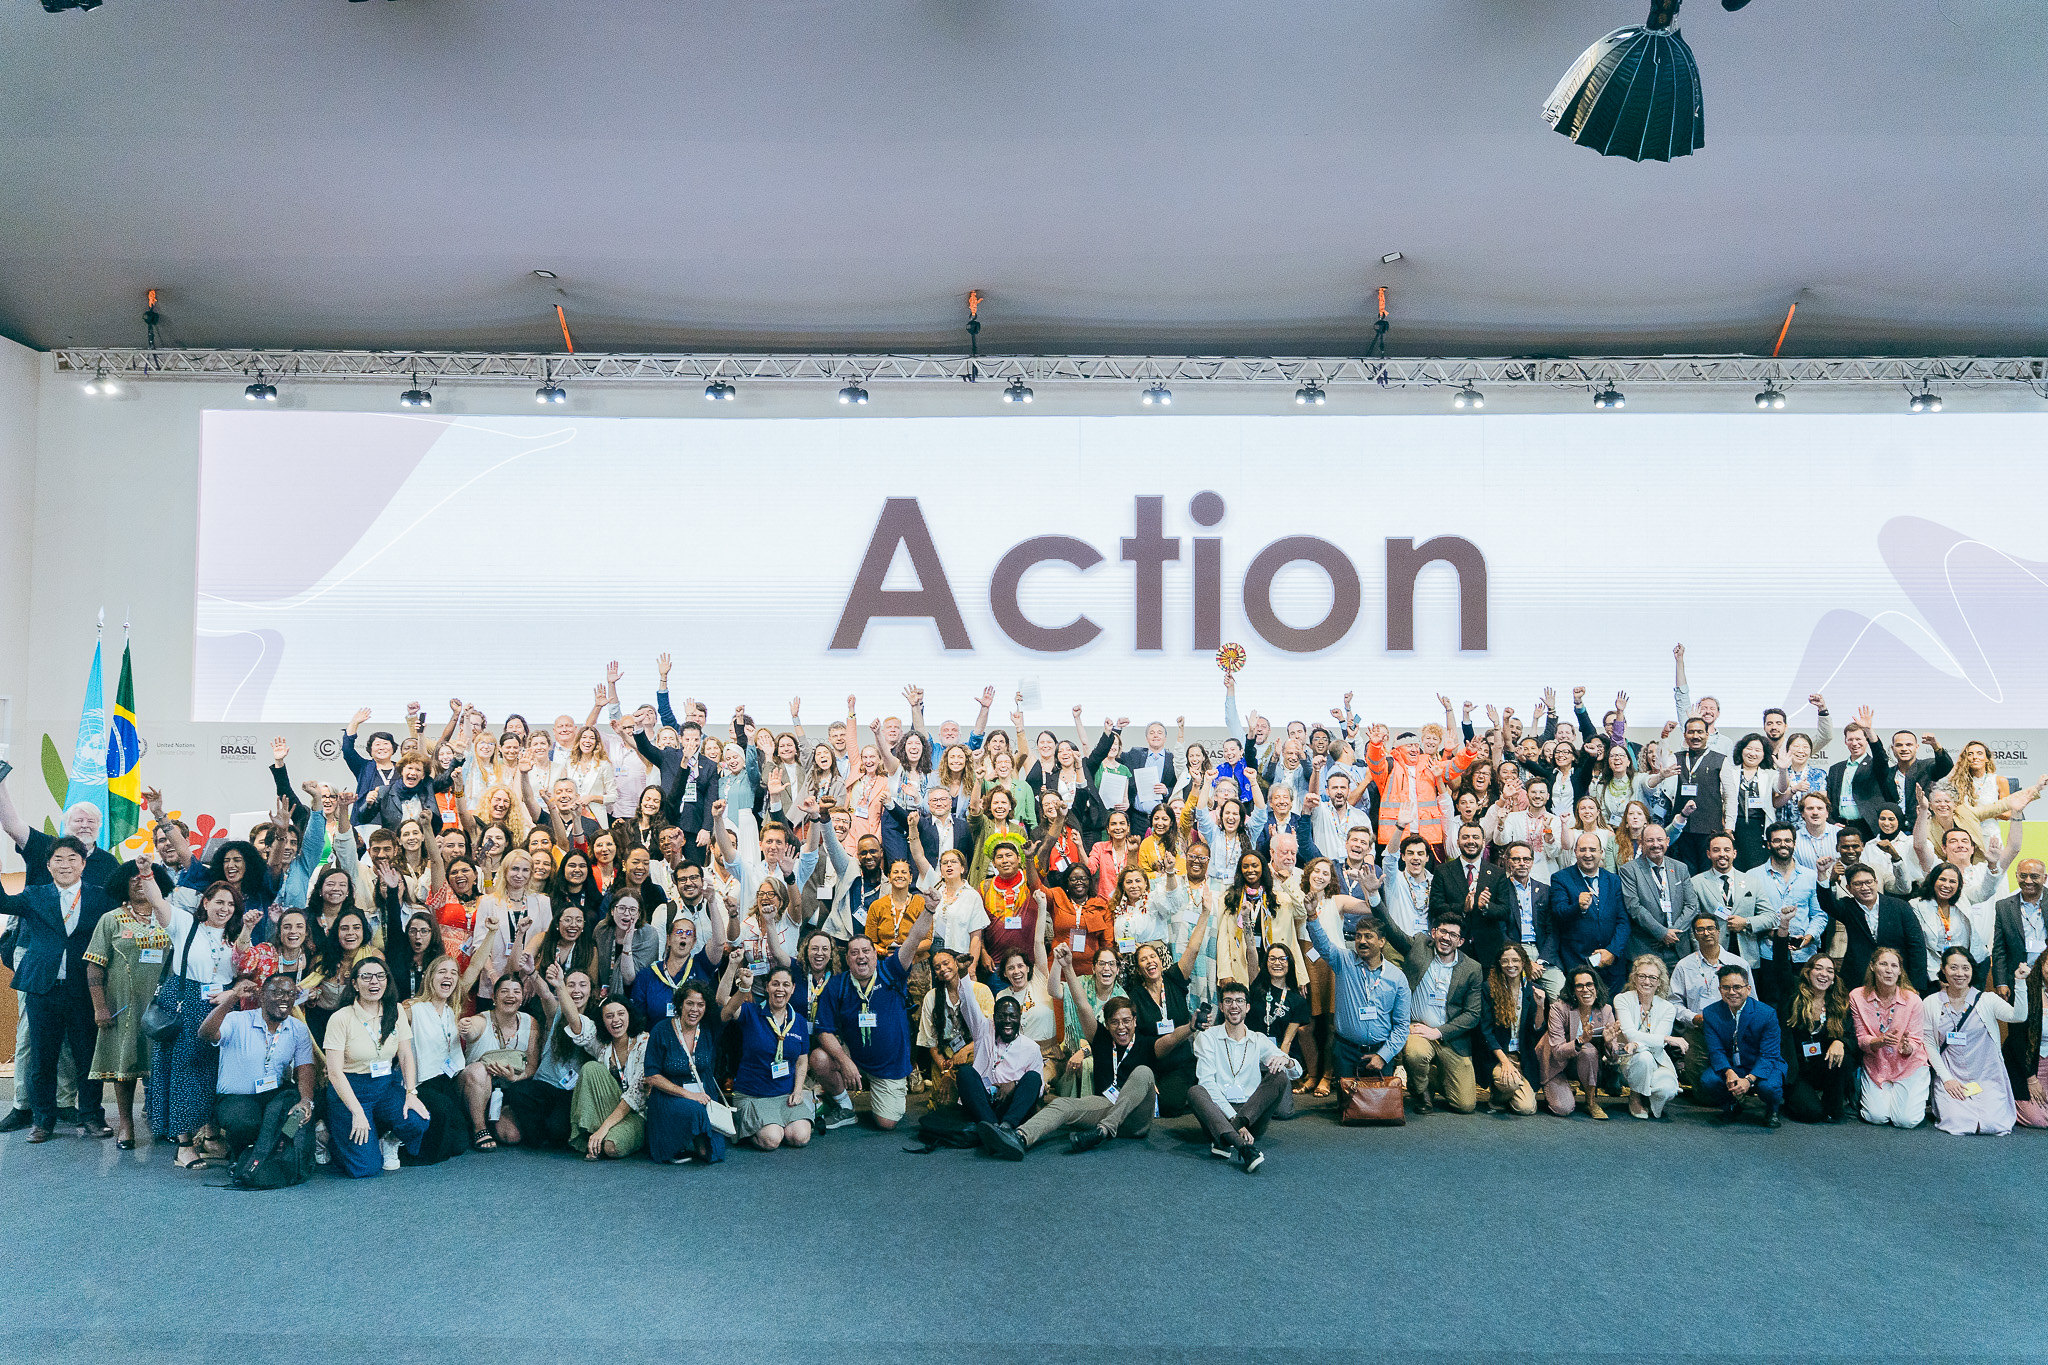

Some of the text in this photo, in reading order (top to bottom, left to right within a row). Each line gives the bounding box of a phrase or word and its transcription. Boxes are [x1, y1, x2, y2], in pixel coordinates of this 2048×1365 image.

[829, 490, 1488, 652] Action
[221, 735, 258, 745] COP30
[1991, 740, 2029, 750] COP30
[220, 746, 257, 755] BRASIL
